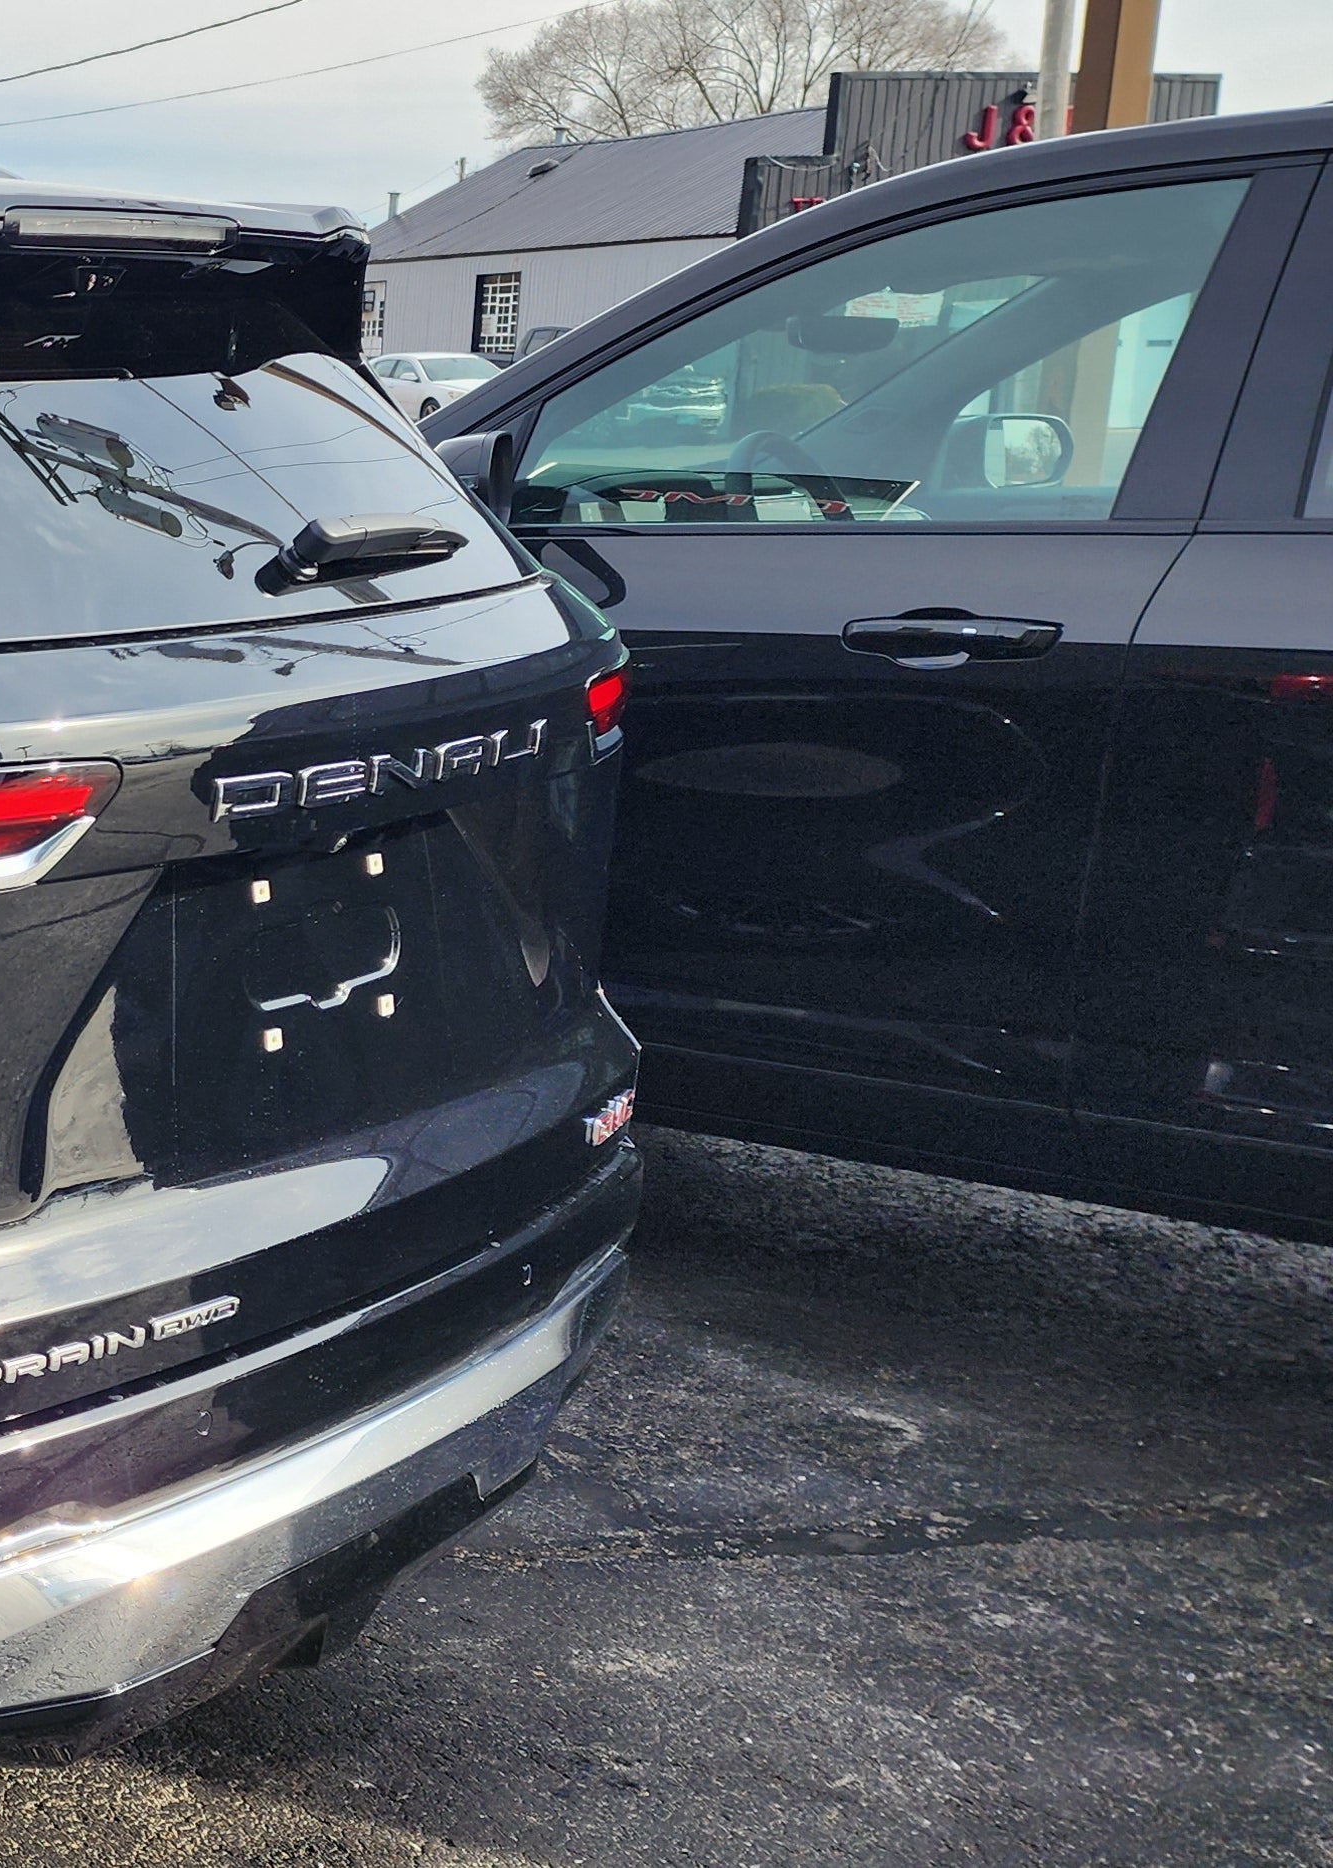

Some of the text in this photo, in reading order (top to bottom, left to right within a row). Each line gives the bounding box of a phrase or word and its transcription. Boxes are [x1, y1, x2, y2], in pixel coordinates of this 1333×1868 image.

[965, 105, 998, 151] J
[211, 718, 548, 823] DENALI
[153, 1298, 239, 1340] AWD
